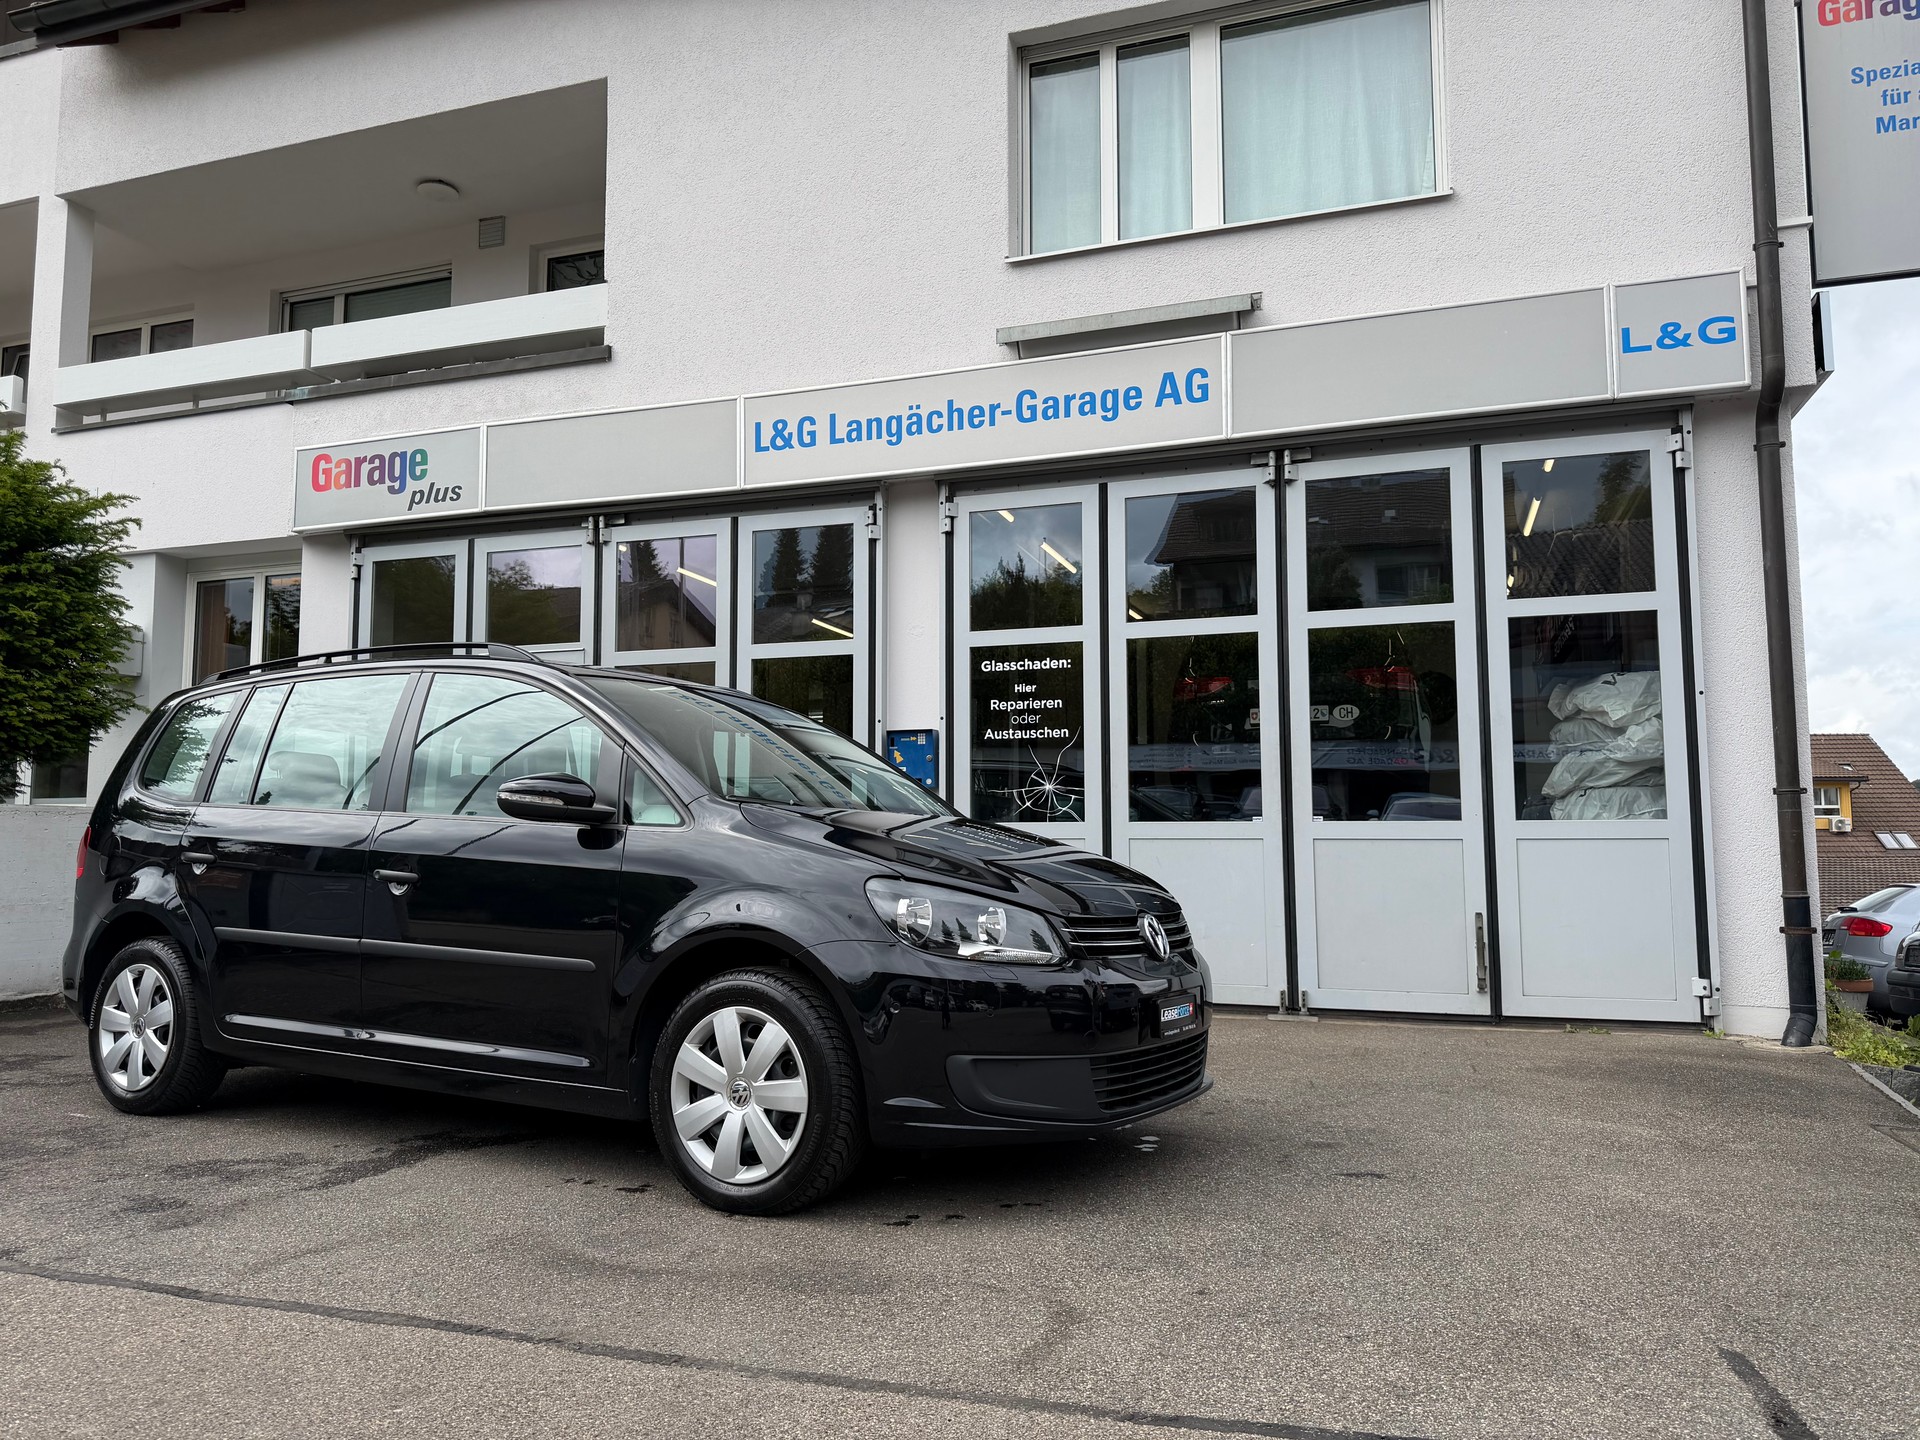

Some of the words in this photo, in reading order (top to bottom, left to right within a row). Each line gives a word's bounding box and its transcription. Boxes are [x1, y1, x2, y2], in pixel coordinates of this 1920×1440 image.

[1850, 59, 1920, 87] Spezia
[1881, 88, 1911, 107] für
[1875, 115, 1920, 134] Mar
[1621, 315, 1737, 354] L&G
[754, 415, 817, 453] L&G
[829, 385, 1143, 446] Langächer-Garage
[1155, 367, 1209, 408] AG
[311, 448, 429, 495] Garage
[407, 481, 463, 511] plus
[980, 657, 1072, 672] Glasschaden:
[1014, 683, 1037, 693] Hier
[990, 698, 1063, 712] Reparieren
[1338, 706, 1354, 719] CH
[1011, 712, 1042, 724] oder
[984, 726, 1069, 740] Austauschen
